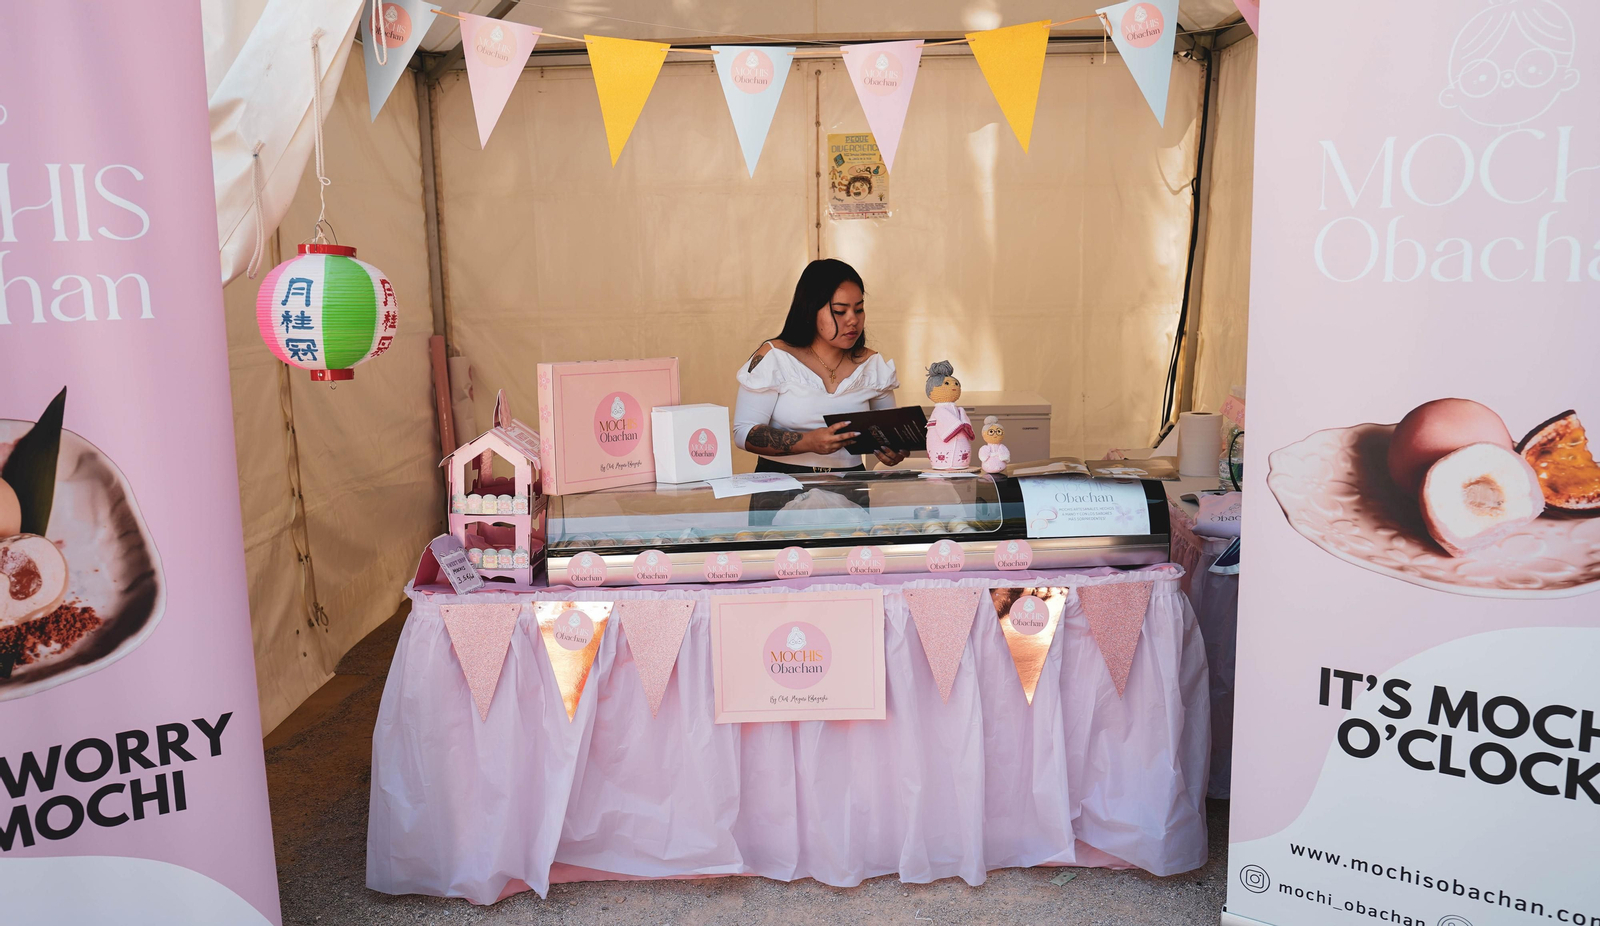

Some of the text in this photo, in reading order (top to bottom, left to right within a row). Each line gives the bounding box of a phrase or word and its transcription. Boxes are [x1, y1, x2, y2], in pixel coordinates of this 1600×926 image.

[1125, 19, 1159, 32] MOCHIS
[1126, 28, 1160, 41] Obachan
[478, 37, 511, 54] MOCHIS
[476, 44, 508, 62] Obachan
[735, 67, 768, 77] MOCHIS
[734, 75, 768, 86] Obachan
[863, 77, 898, 87] Obachan
[280, 277, 318, 362] 月桂冠
[599, 418, 638, 432] MOCHIS
[600, 431, 638, 443] Obachan
[1055, 492, 1114, 503] Obachan
[930, 555, 961, 564] MOCHIS
[998, 552, 1028, 561] MOCHIS
[707, 564, 738, 572] MOCHIS
[778, 562, 808, 570] MOCHIS
[930, 562, 961, 570] Obachan
[998, 560, 1028, 568] Obachan
[571, 566, 602, 574] MOCHIS
[636, 565, 668, 573] MOCHIS
[778, 568, 809, 577] Obachan
[850, 566, 881, 574] Obachan
[570, 573, 602, 582] Obachan
[636, 572, 668, 580] Obachan
[707, 571, 738, 580] Obachan
[1013, 611, 1044, 620] MOCHIS
[1012, 618, 1044, 627] Obachan
[556, 632, 587, 644] Obachan
[770, 650, 823, 663] MOCHIS
[770, 662, 823, 674] Obachan
[770, 696, 777, 704] By
[0, 711, 234, 799] WORRY
[0, 770, 187, 852] MOCHI
